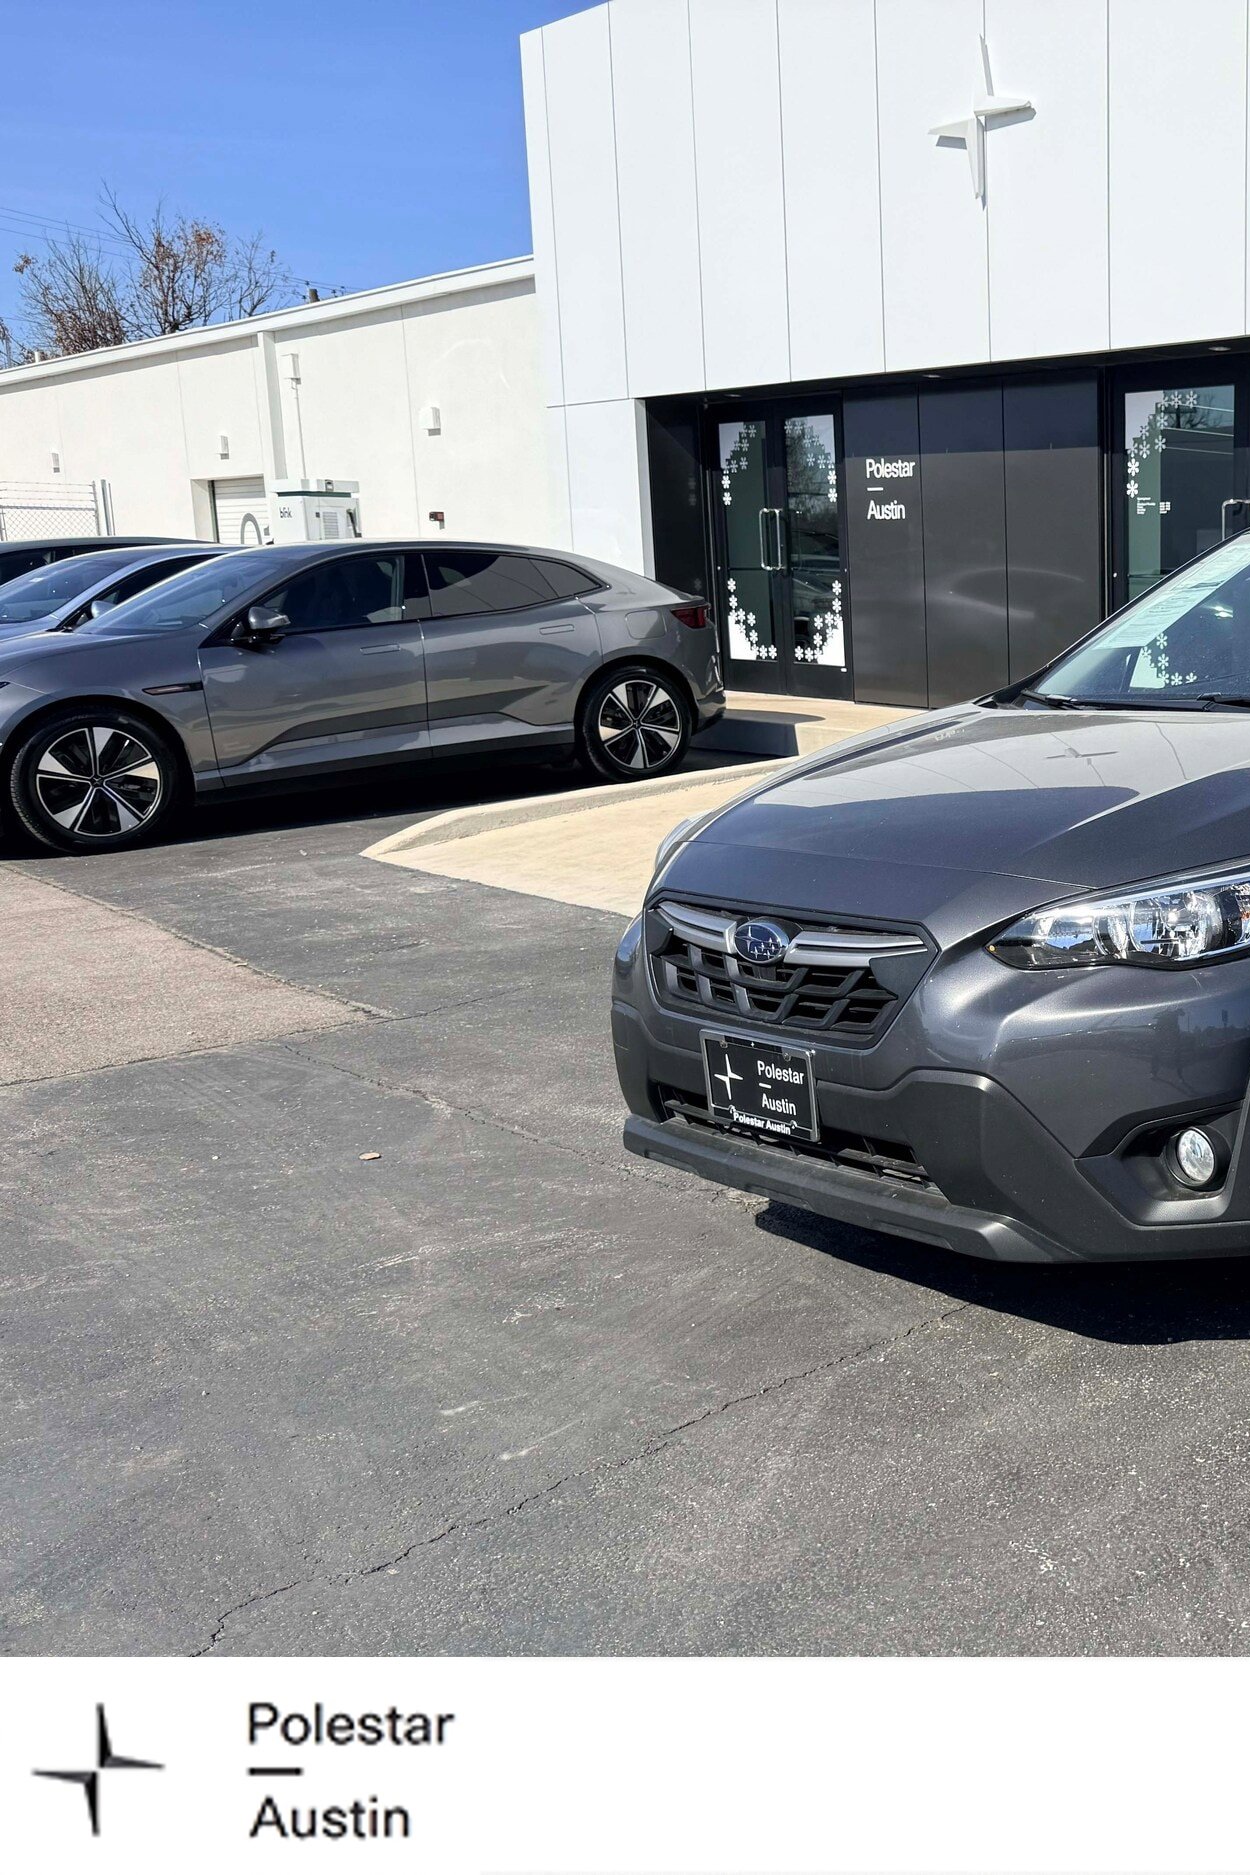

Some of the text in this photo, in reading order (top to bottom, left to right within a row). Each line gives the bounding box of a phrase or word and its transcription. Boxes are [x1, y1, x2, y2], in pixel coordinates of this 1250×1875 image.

[865, 457, 916, 479] Polestar
[866, 499, 906, 520] Austin
[757, 1060, 805, 1085] Polestar
[762, 1093, 797, 1116] Austin
[733, 1111, 791, 1136] Polestar Austin
